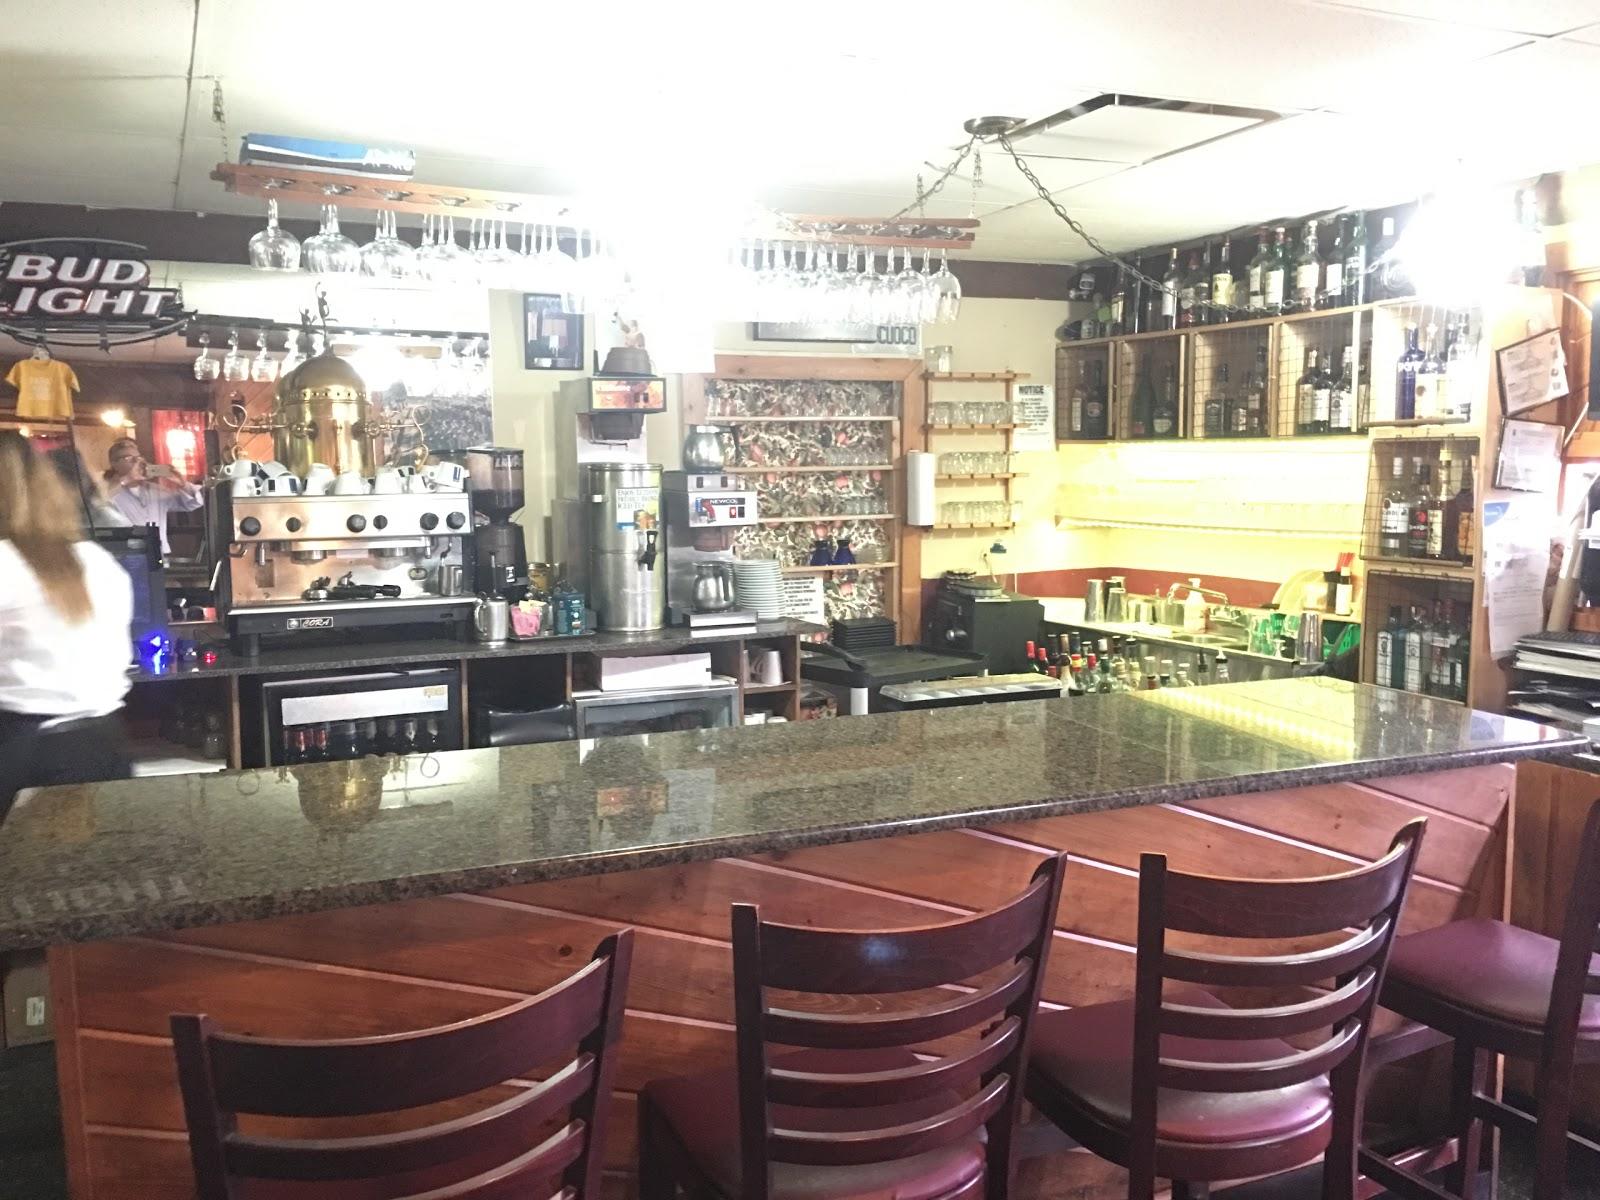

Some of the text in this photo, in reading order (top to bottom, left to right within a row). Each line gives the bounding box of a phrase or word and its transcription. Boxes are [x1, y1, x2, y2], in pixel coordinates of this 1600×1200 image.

[6, 254, 149, 285] BUD
[1018, 385, 1044, 396] NOTICE
[302, 618, 331, 629] CORA
